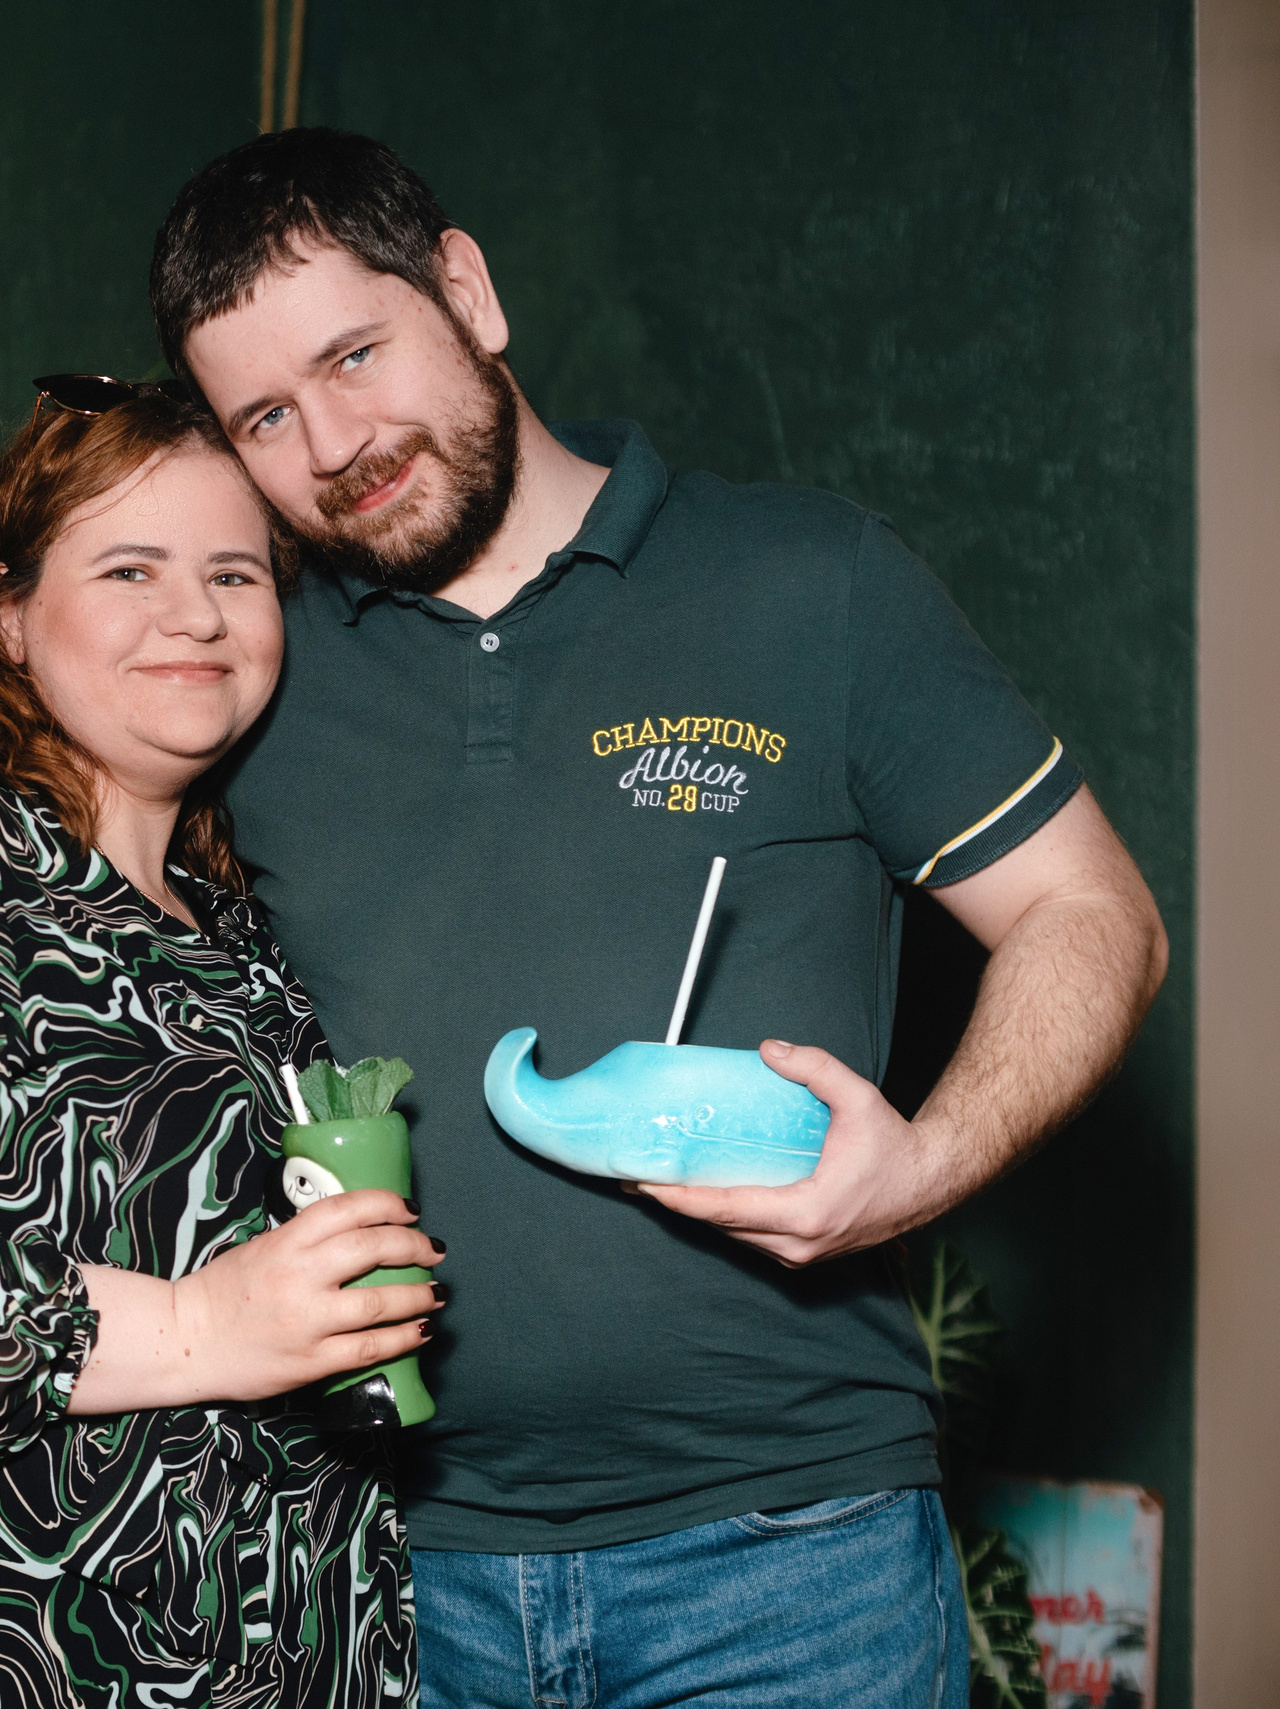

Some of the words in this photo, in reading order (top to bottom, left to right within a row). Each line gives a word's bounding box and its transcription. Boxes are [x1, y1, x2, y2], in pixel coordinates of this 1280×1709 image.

[591, 717, 787, 763] CHAMPIONS
[618, 745, 749, 795] Albion
[631, 788, 665, 808] NO.
[701, 791, 740, 813] CUP
